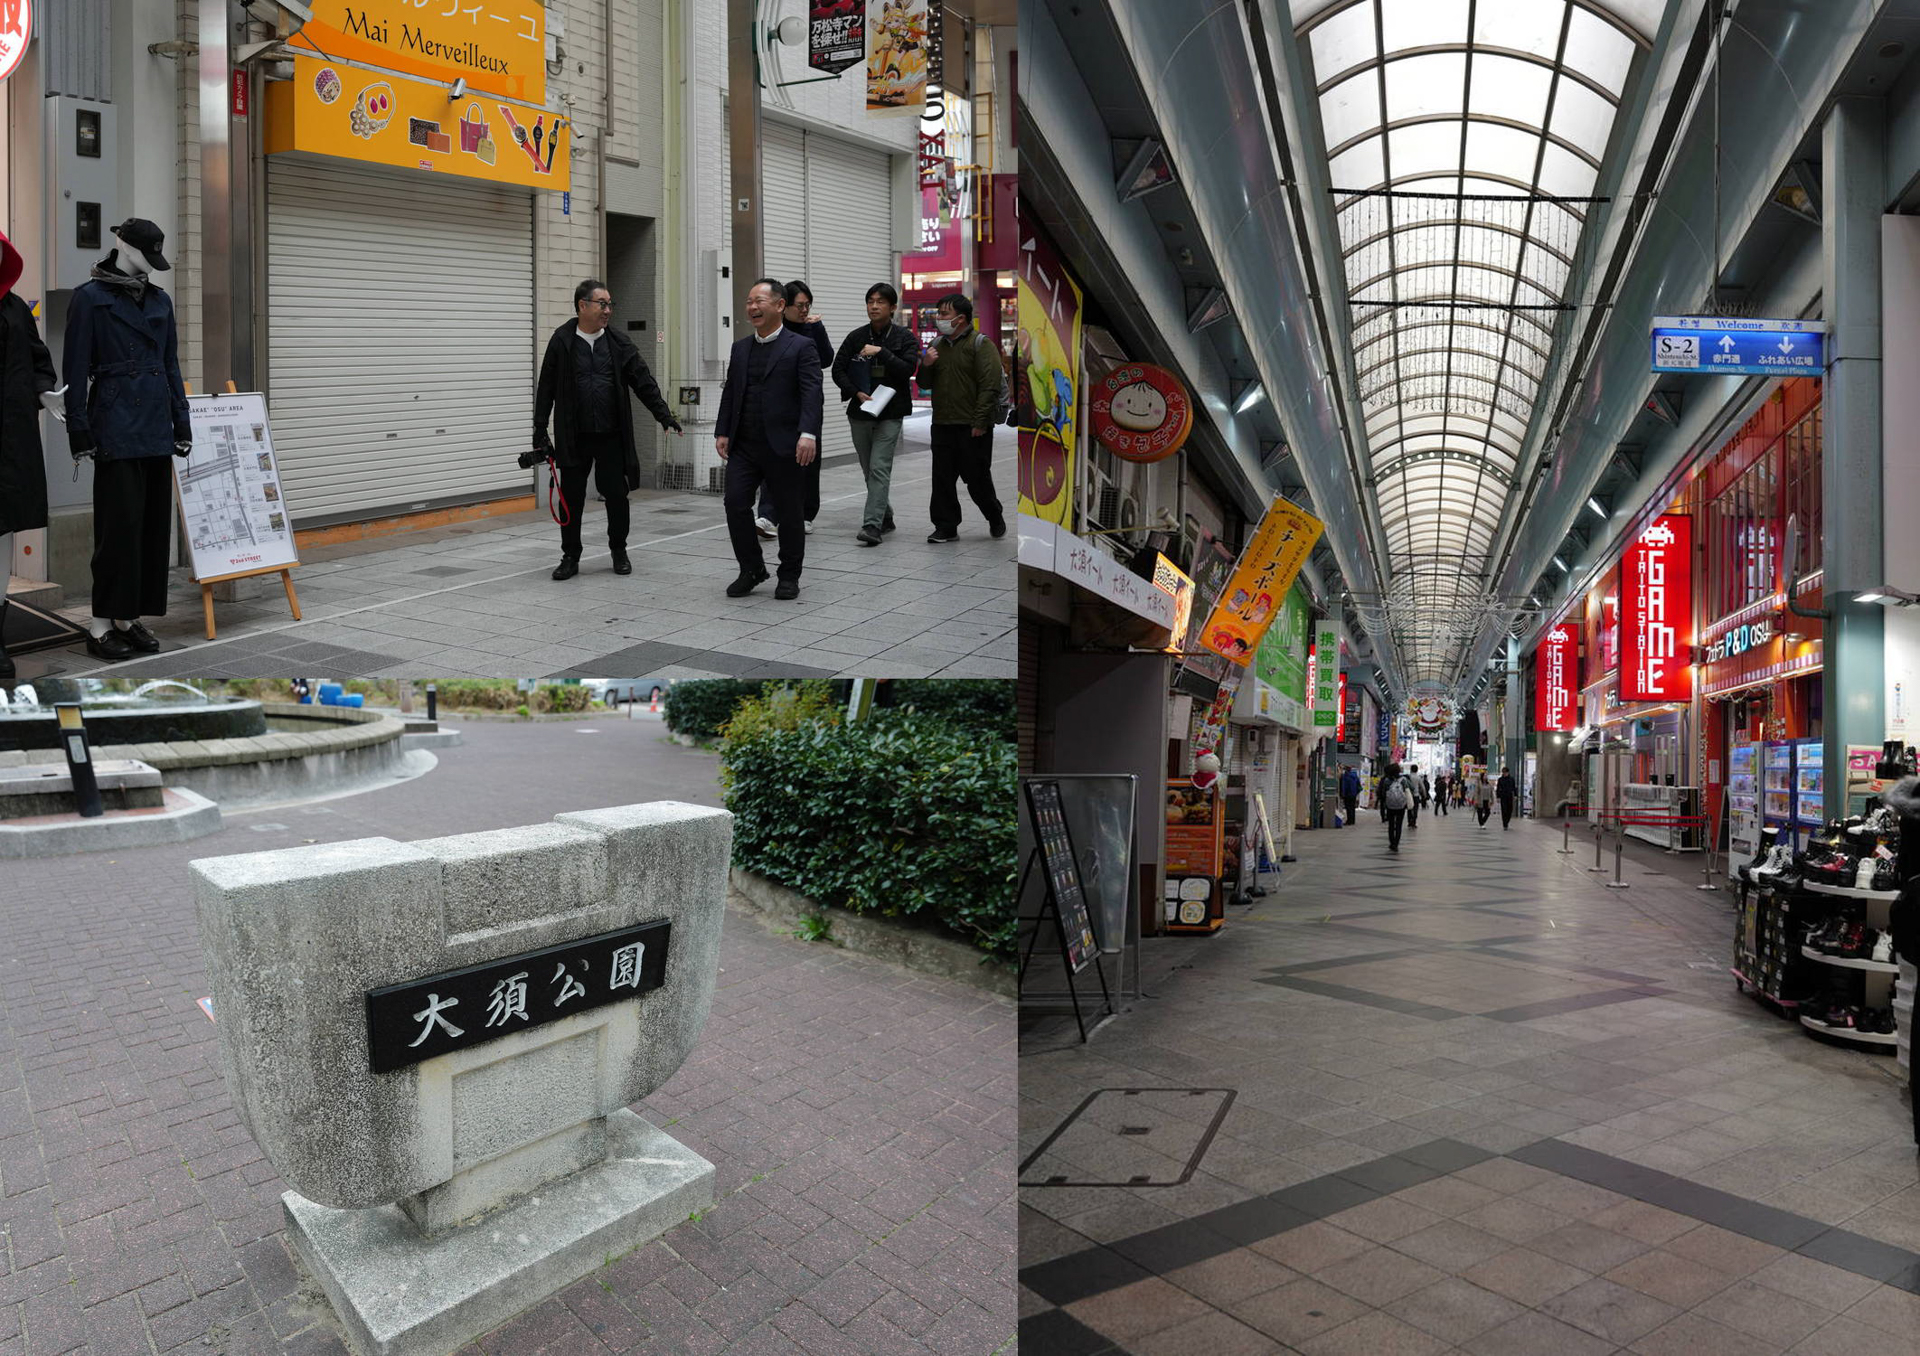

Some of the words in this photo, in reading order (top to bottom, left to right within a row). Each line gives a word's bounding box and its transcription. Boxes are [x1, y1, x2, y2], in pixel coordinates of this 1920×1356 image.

[343, 7, 388, 44] Mai
[400, 23, 509, 75] Merveilleux
[811, 15, 863, 34] 万松寺マン
[1661, 338, 1693, 354] S-2
[1716, 320, 1764, 330] Welcome
[1713, 354, 1740, 364] 赤門通
[1758, 355, 1814, 366] ふれあい広場
[1239, 529, 1294, 621] チーズボール
[1638, 550, 1646, 608] TAITO
[1638, 611, 1646, 693] STATION
[1648, 550, 1674, 693] GAME
[1725, 625, 1749, 657] P&D
[1319, 631, 1335, 701] 携帯買取
[1552, 645, 1568, 728] GAME
[408, 942, 645, 1047] 大須公園
